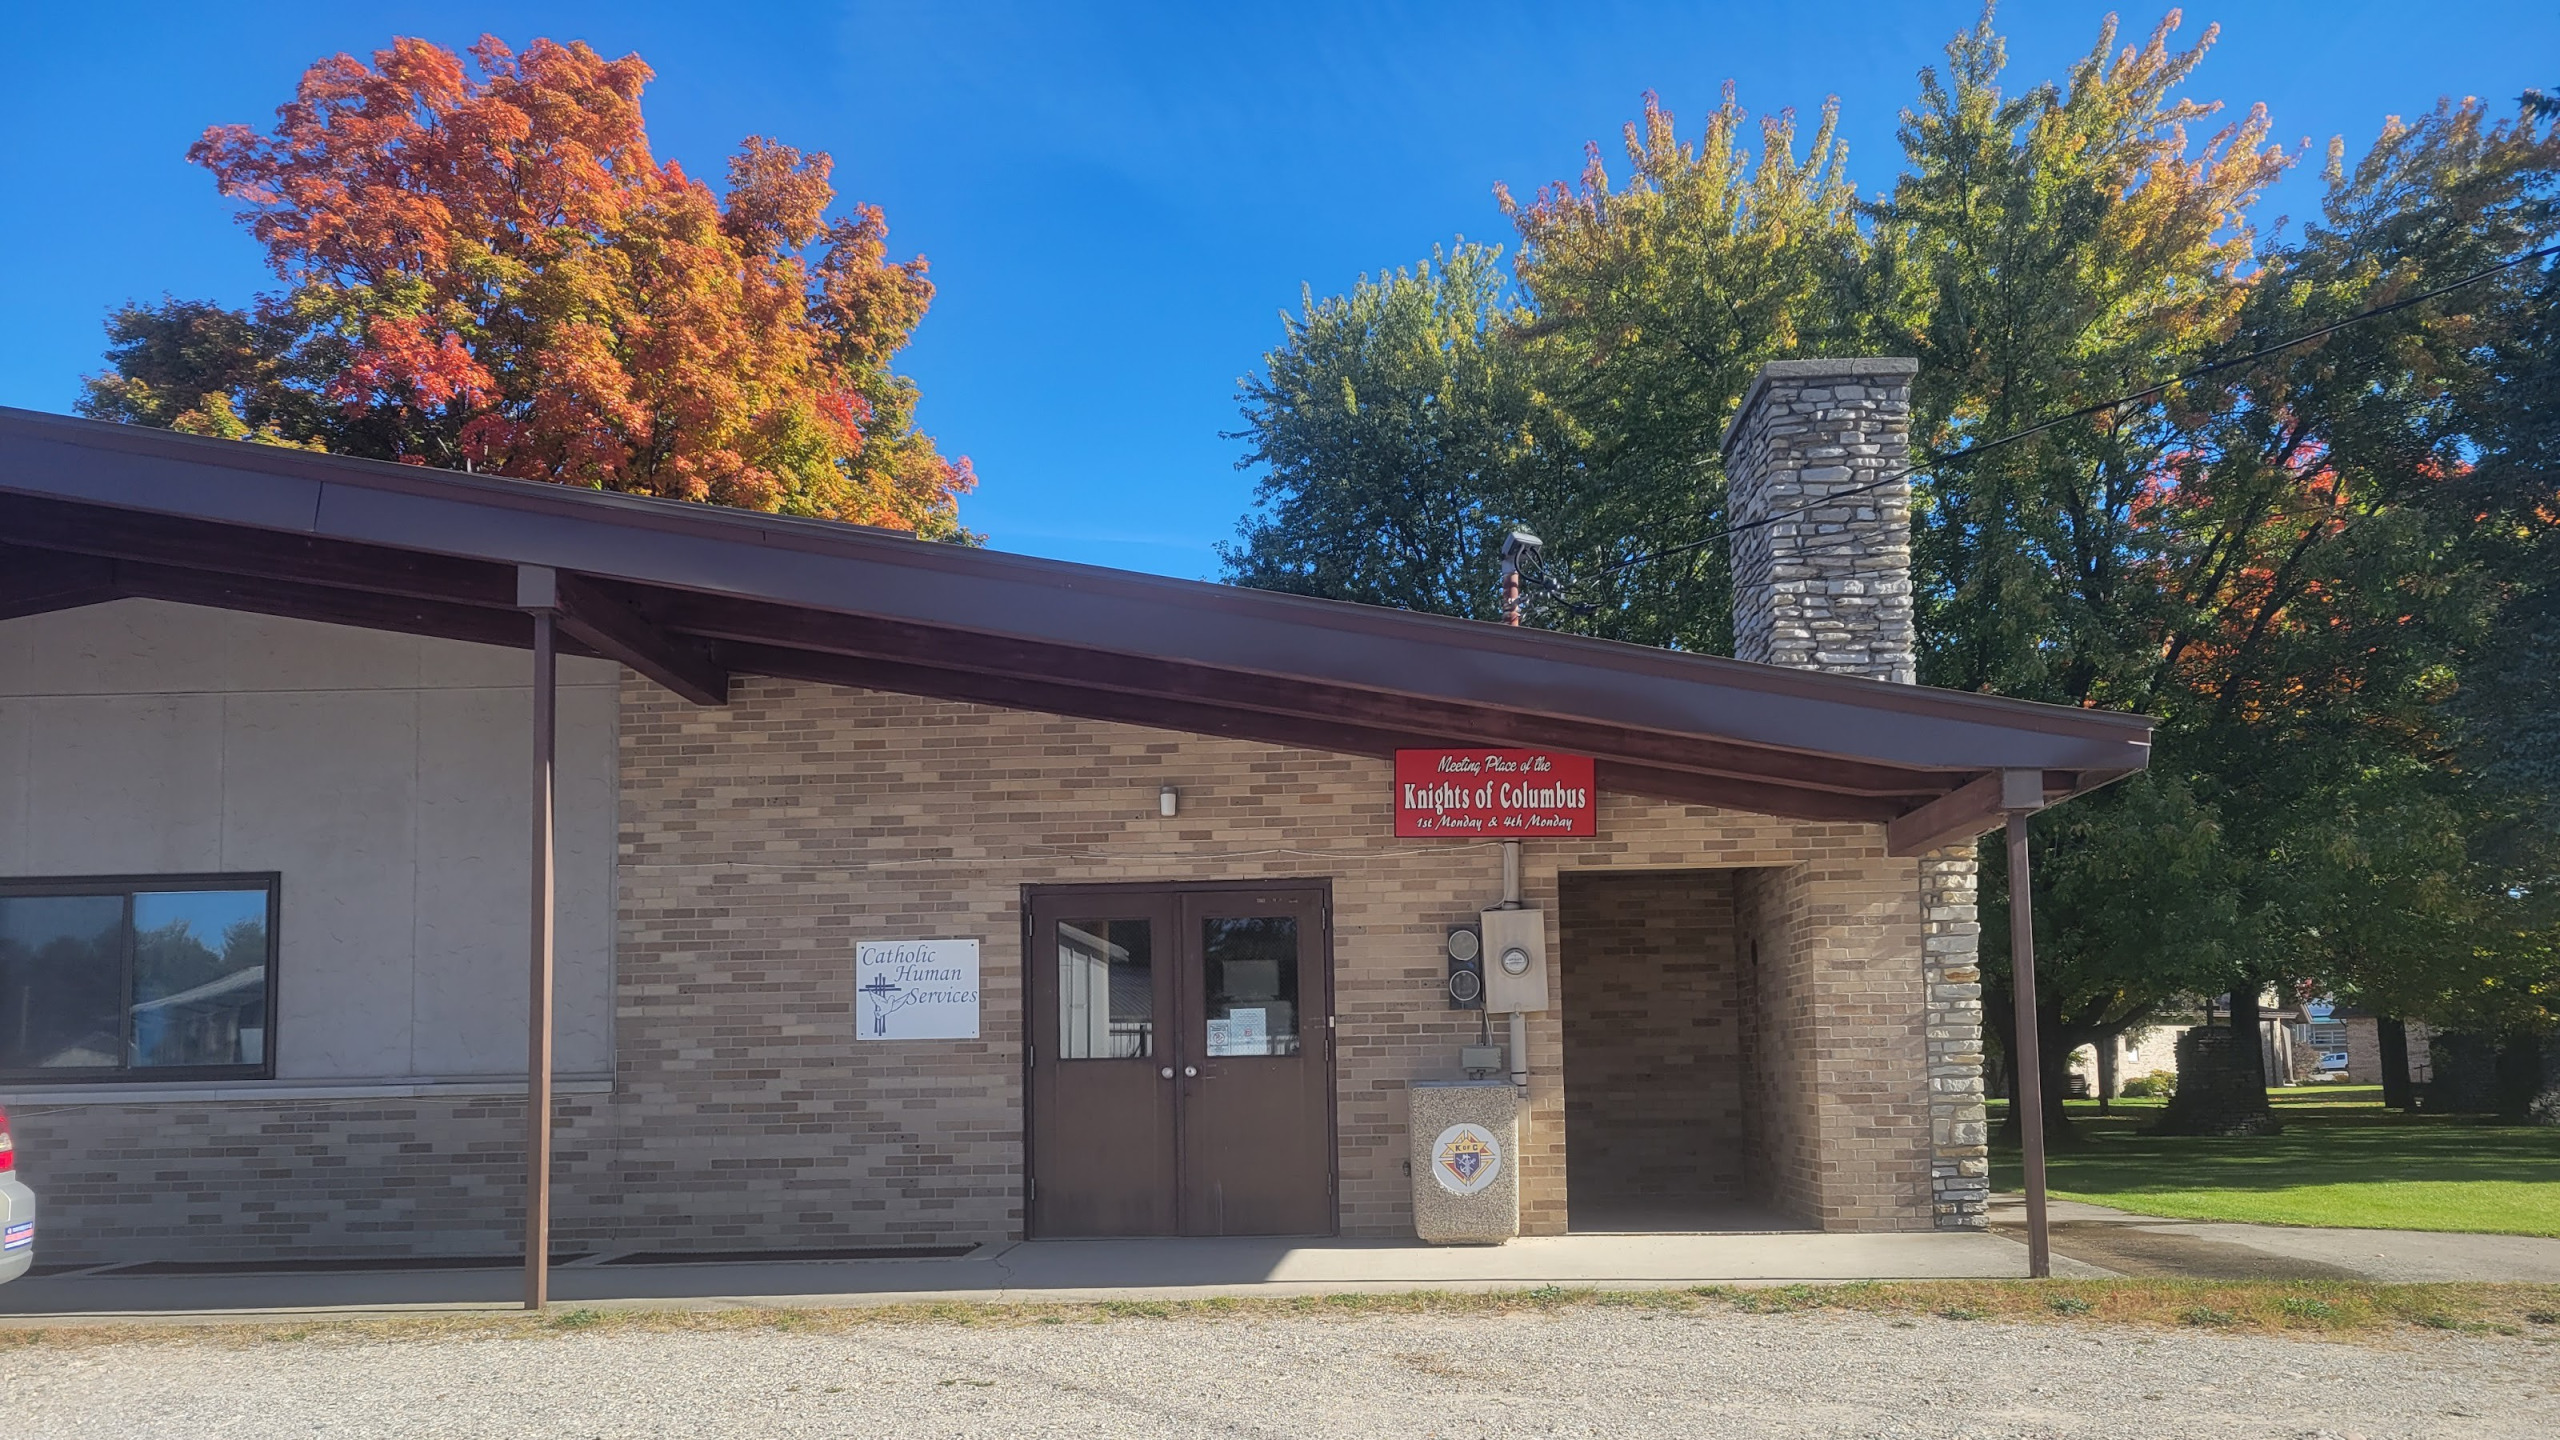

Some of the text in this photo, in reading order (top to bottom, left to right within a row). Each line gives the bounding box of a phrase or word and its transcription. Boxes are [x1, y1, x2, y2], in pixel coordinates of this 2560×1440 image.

[1437, 755, 1551, 776] Meeting Place of the
[1404, 780, 1586, 815] Knights of Columbus
[1416, 814, 1573, 831] 1st Monday & 4th Monday
[862, 944, 936, 966] Catholic
[894, 964, 962, 982] Human
[906, 986, 978, 1005] Services
[1455, 1144, 1461, 1152] K
